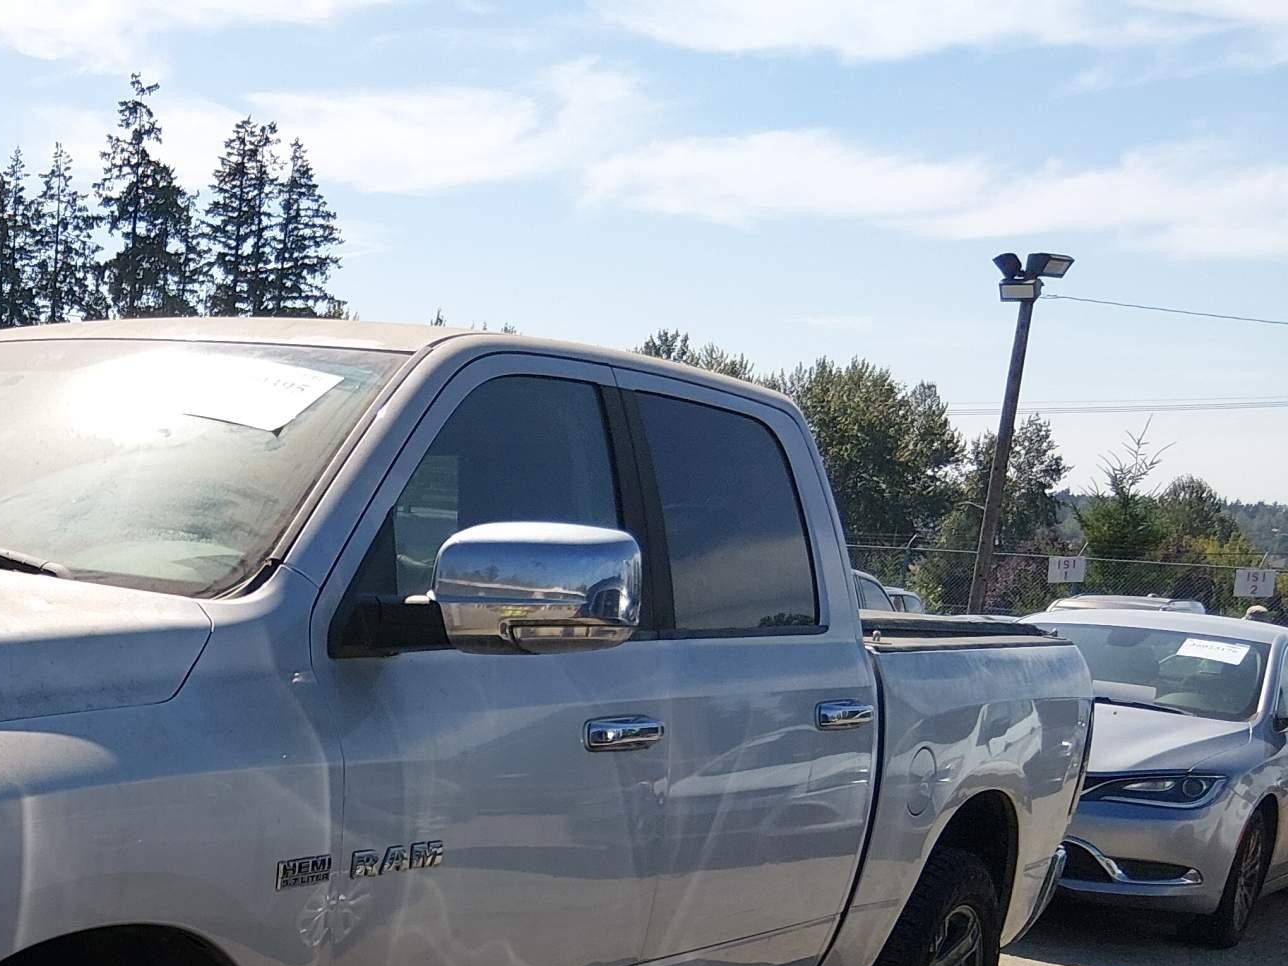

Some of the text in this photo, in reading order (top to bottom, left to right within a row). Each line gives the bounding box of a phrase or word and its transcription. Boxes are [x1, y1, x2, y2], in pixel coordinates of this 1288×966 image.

[1250, 584, 1258, 595] 2
[282, 856, 332, 878] HEMI
[350, 840, 444, 879] RAM
[300, 872, 330, 884] LITER
